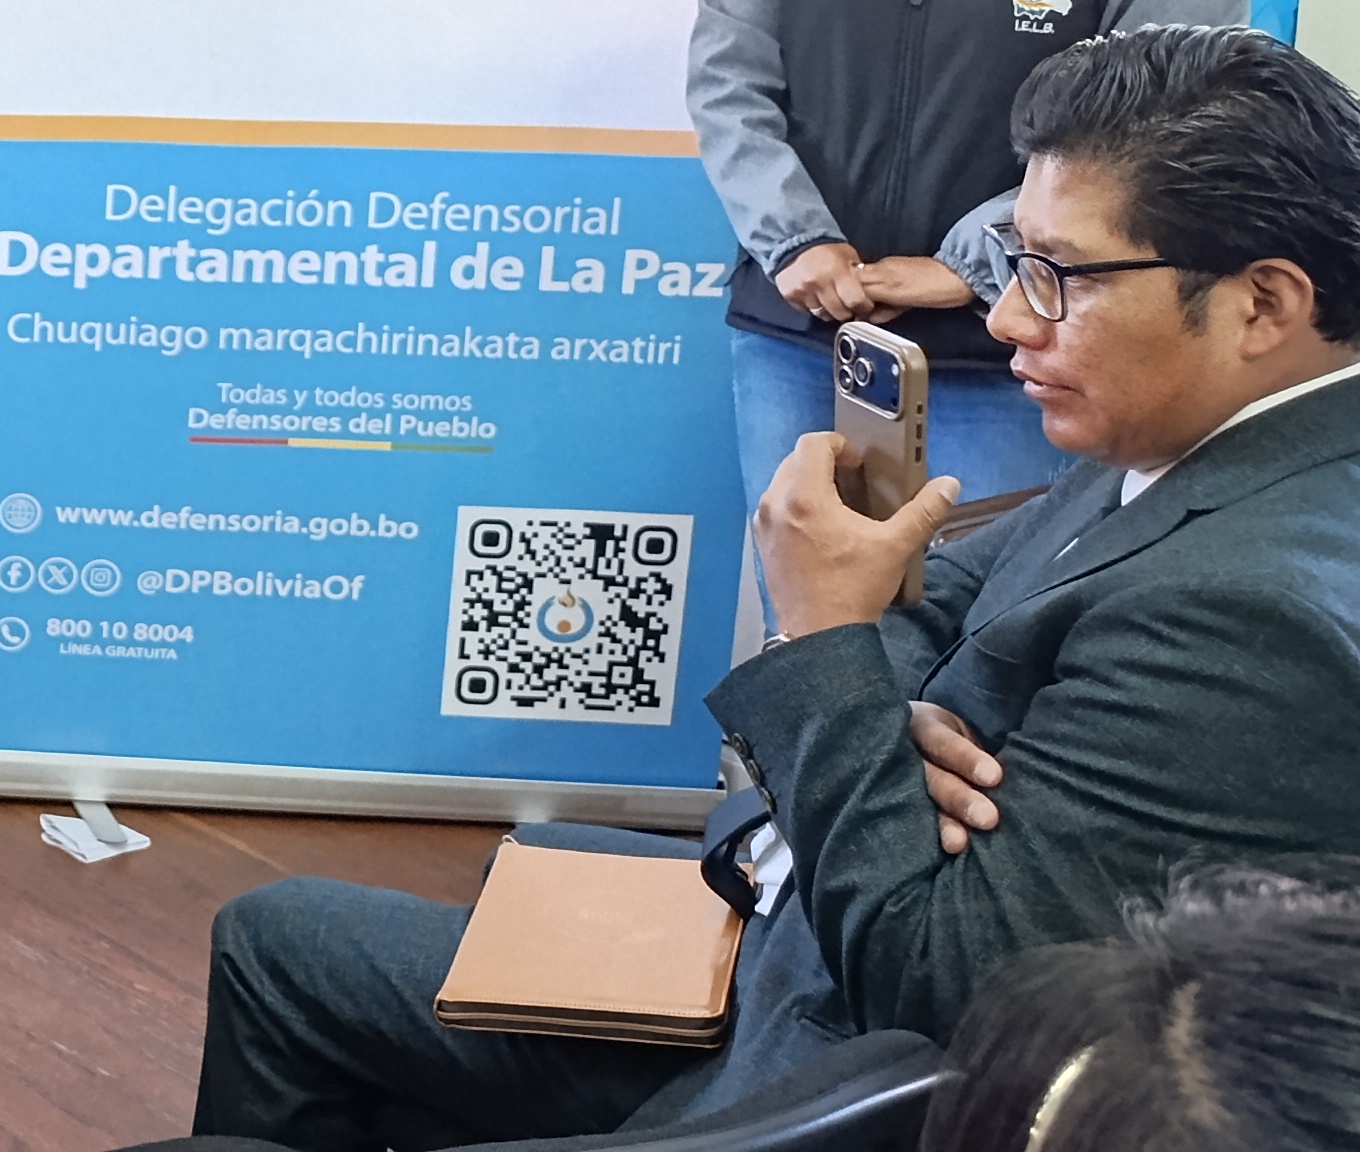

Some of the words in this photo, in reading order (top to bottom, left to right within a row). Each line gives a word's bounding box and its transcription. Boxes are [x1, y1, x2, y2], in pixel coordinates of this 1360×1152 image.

[105, 184, 353, 236] Delegación
[367, 191, 622, 236] Defensorial
[449, 241, 525, 291] de
[538, 245, 606, 294] La
[621, 248, 726, 298] Paz
[7, 311, 209, 357] Chuquiago
[218, 322, 540, 360] marqachirinakata
[550, 334, 681, 365] arxatiri
[216, 382, 287, 406] Todas
[293, 389, 308, 411] y
[314, 385, 386, 409] todos
[391, 393, 473, 412] somos
[187, 407, 342, 433] Defensores
[348, 412, 393, 435] del
[399, 414, 497, 439] Pueblo
[55, 504, 420, 541] www.defensoria.gob.bo
[136, 568, 366, 601] @DPBoliviaOf
[46, 617, 93, 639] 800
[99, 620, 129, 641] 10
[132, 622, 195, 643] 8004
[59, 642, 104, 656] LÍNEA
[104, 645, 178, 660] GRATUITA
